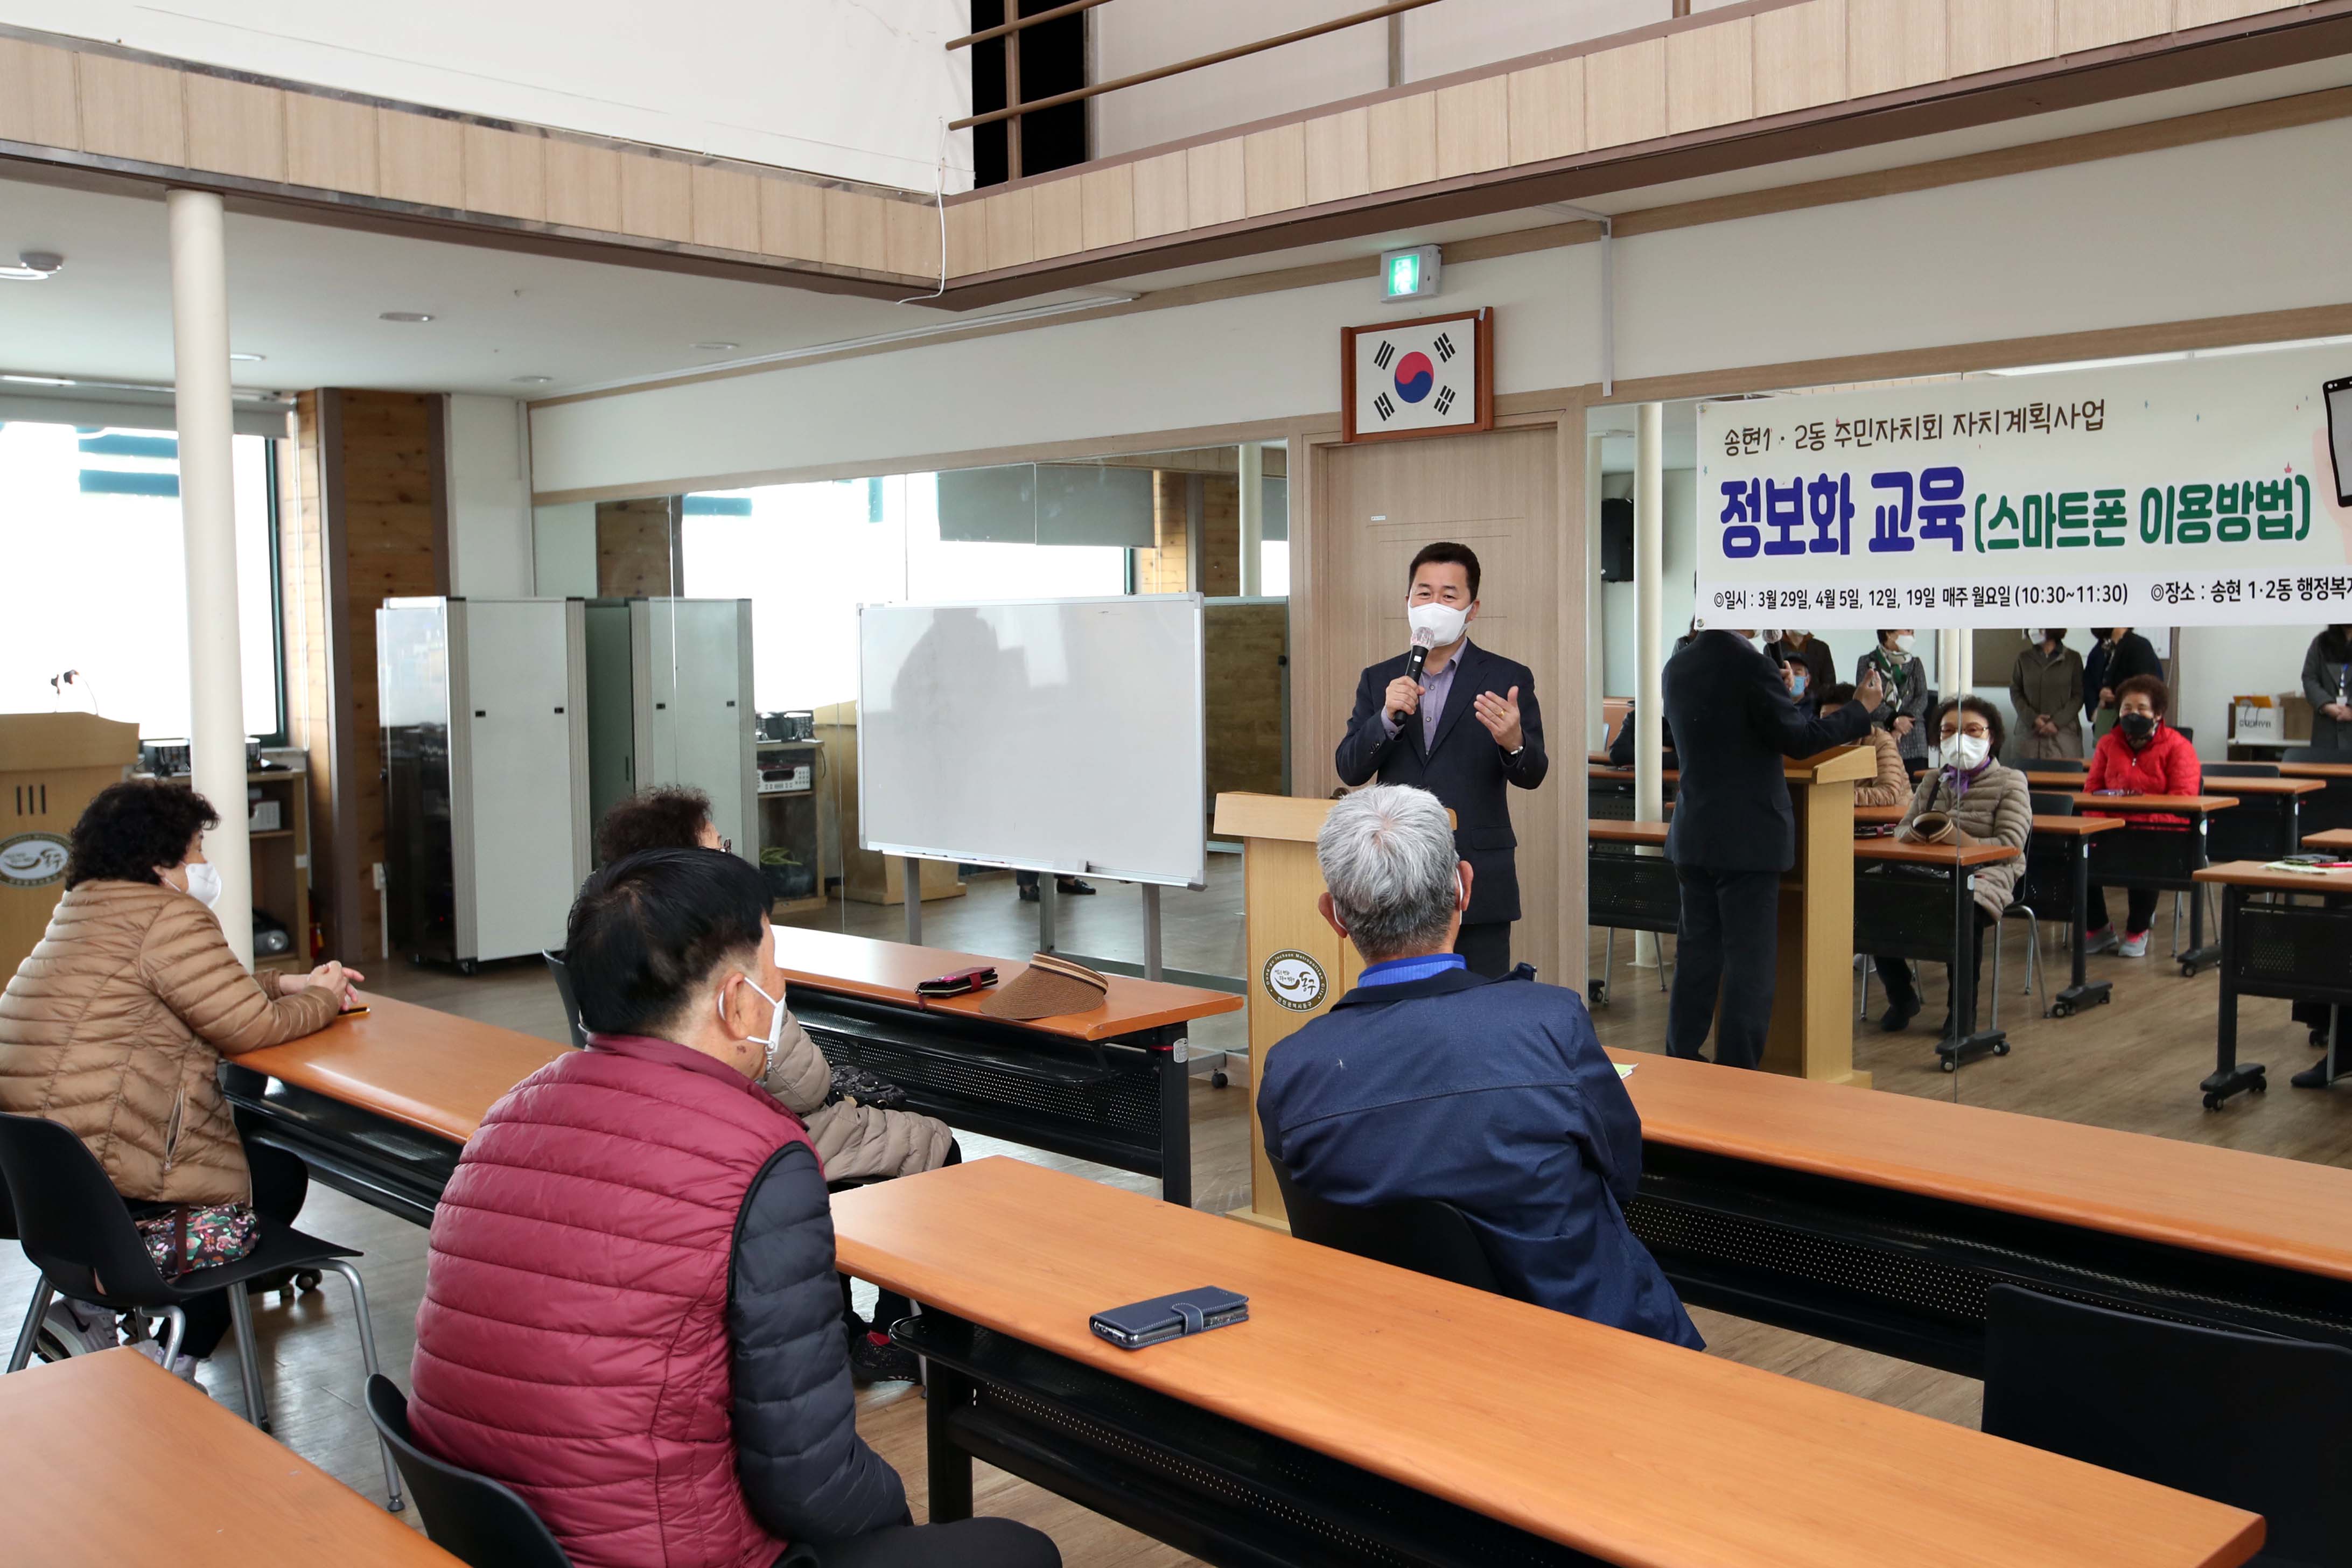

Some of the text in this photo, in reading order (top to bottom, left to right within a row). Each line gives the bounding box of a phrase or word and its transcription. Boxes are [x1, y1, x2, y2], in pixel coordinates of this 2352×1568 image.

[1834, 414, 1942, 448] 주민자치회
[1953, 398, 2104, 437] 자치계획사업
[1720, 466, 2311, 558] 정보화 교육 (스마트폰 이용방법)
[1758, 590, 1776, 610] 3월
[1780, 589, 1811, 610] 29일,
[1815, 589, 1835, 609] 4월
[1839, 589, 1863, 609] 5일,
[1868, 587, 1900, 609] 12일,
[1907, 587, 1935, 608] 19일
[1943, 586, 1969, 607] 매주
[1971, 585, 2010, 607] 월요일
[2015, 583, 2127, 607] (10:30~11:30)
[2210, 579, 2241, 603] 송현
[2248, 578, 2293, 601] 1·2동
